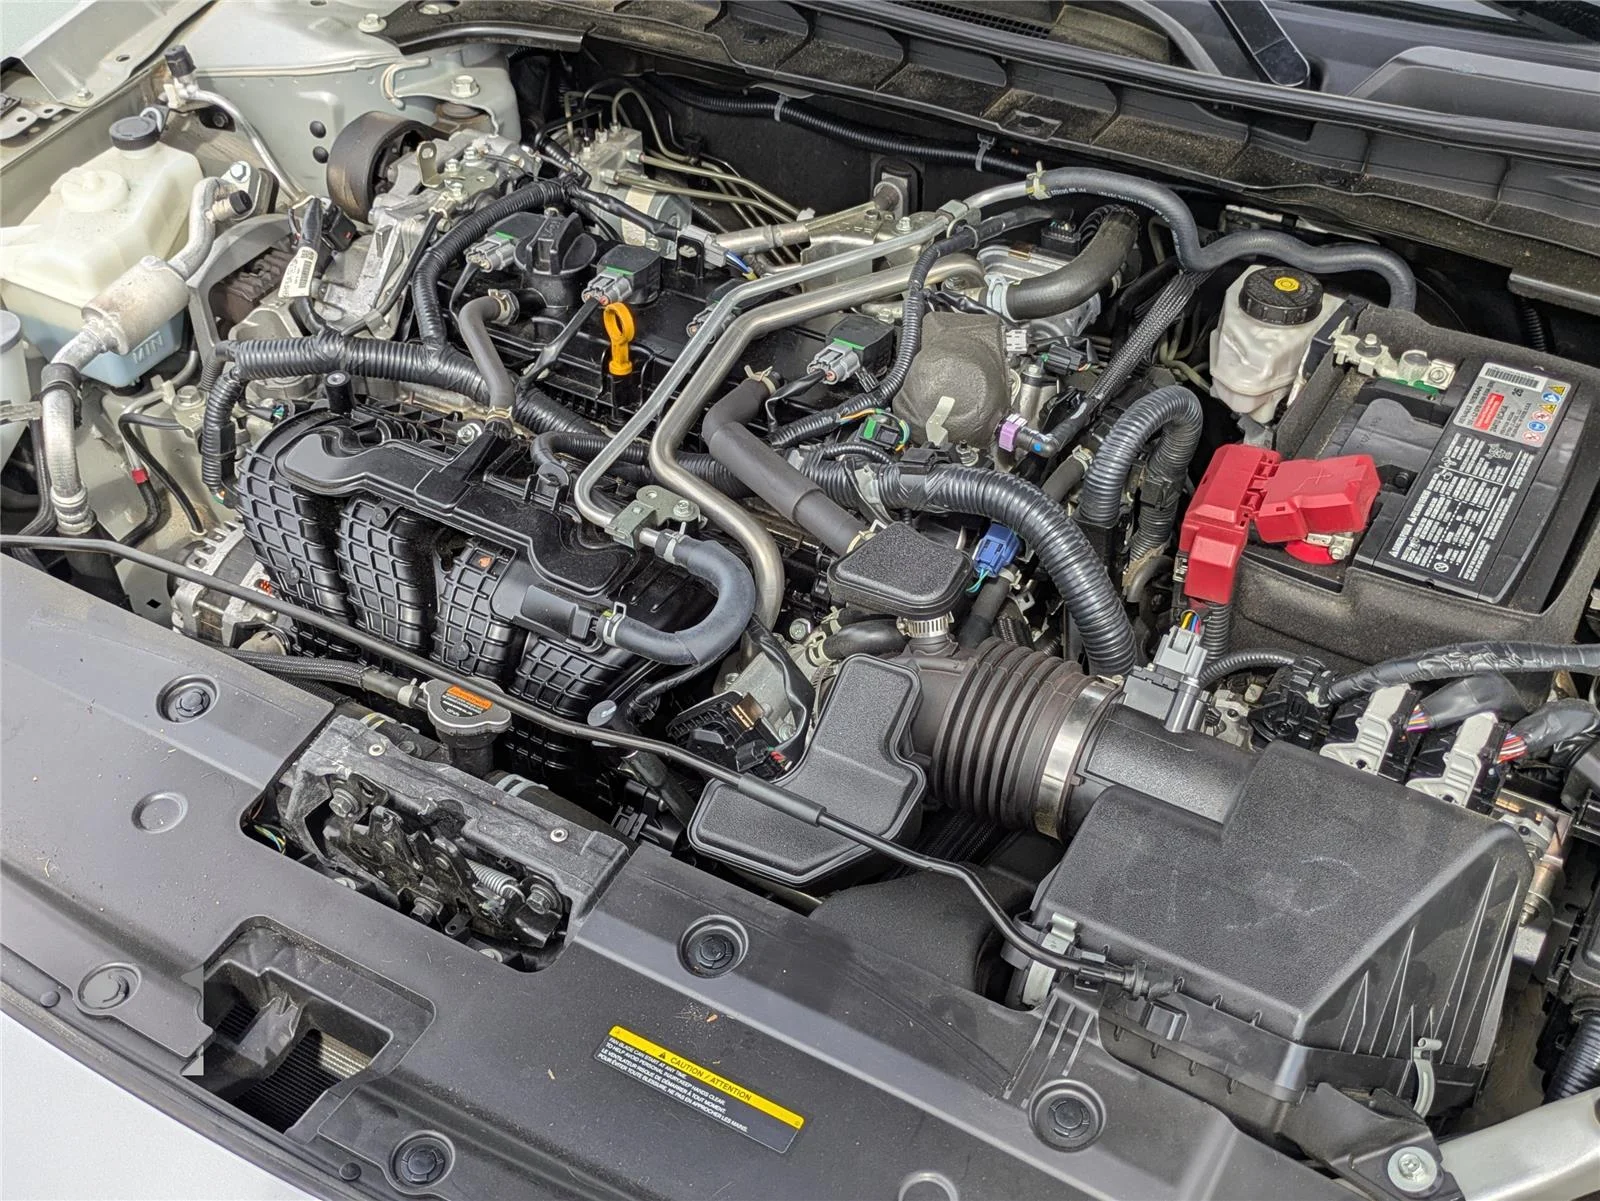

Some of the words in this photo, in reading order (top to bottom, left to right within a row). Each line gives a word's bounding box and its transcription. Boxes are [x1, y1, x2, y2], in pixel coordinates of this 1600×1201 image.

[607, 1050, 637, 1069] VENTILATEUR
[636, 1065, 654, 1077] RISQUE
[661, 1076, 687, 1094] DÉMARRER
[691, 1092, 705, 1103] TOUT
[608, 1036, 619, 1045] FAN
[632, 1048, 645, 1058] CAN
[643, 1054, 659, 1065] START
[664, 1064, 676, 1073] ANY
[611, 1045, 625, 1055] HELP
[623, 1051, 639, 1062] AVOID
[638, 1058, 664, 1075] PERSONAL
[690, 1084, 709, 1097] HANDS
[669, 1056, 704, 1078] CAUTION
[709, 1076, 752, 1101] ATTENTION
[597, 1052, 612, 1063] POUR
[626, 1067, 642, 1079] TOUTE
[674, 1091, 685, 1100] PAS
[684, 1096, 692, 1104] EN
[691, 1100, 723, 1119] APPROCHER
[721, 1115, 731, 1124] LES
